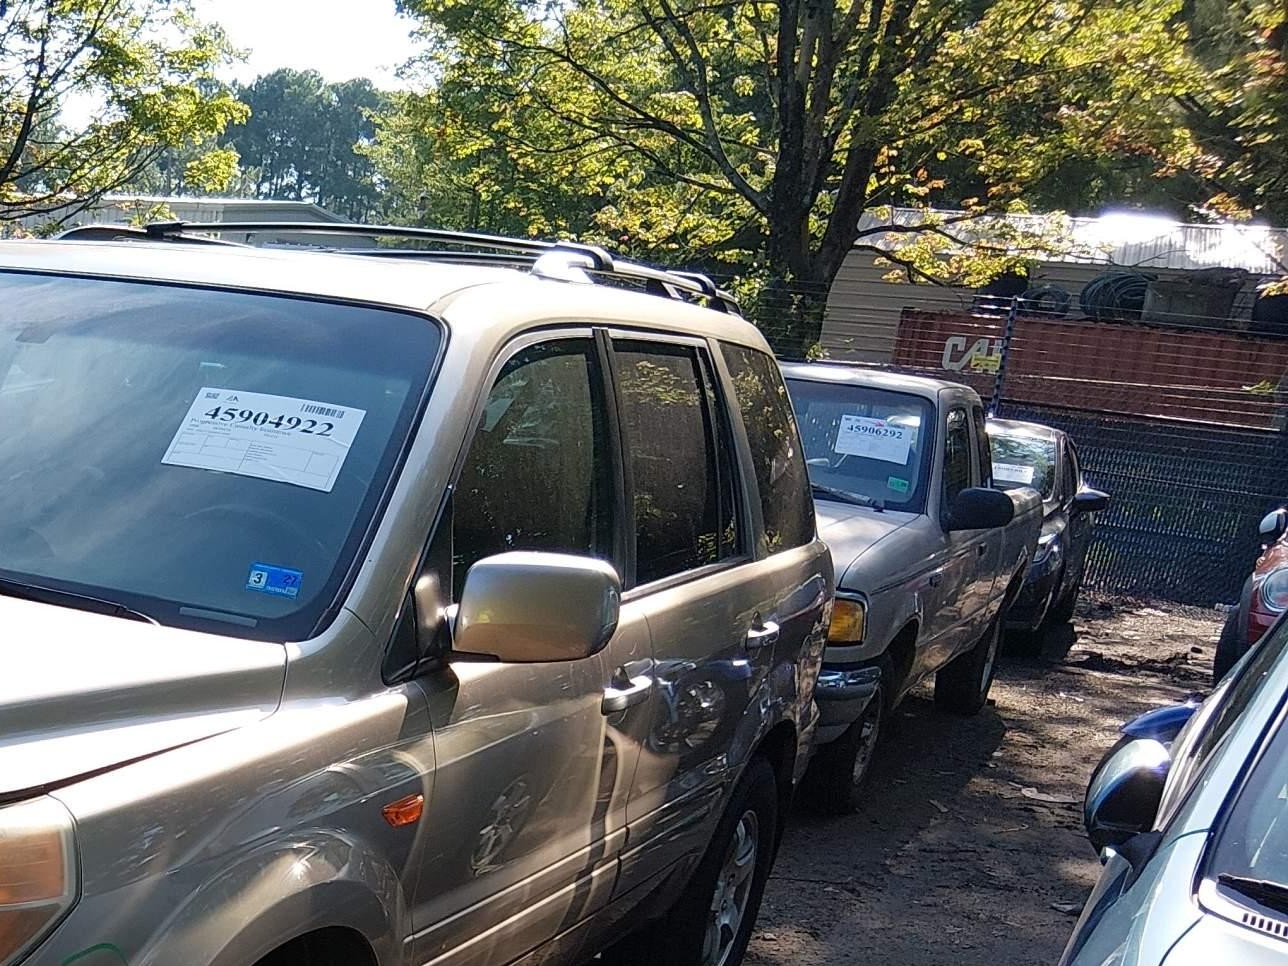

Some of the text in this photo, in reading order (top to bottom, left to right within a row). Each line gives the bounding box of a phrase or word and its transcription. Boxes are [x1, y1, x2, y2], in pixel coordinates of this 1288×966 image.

[204, 405, 334, 437] 45904922
[847, 424, 903, 440] 45906292
[253, 572, 264, 584] 3
